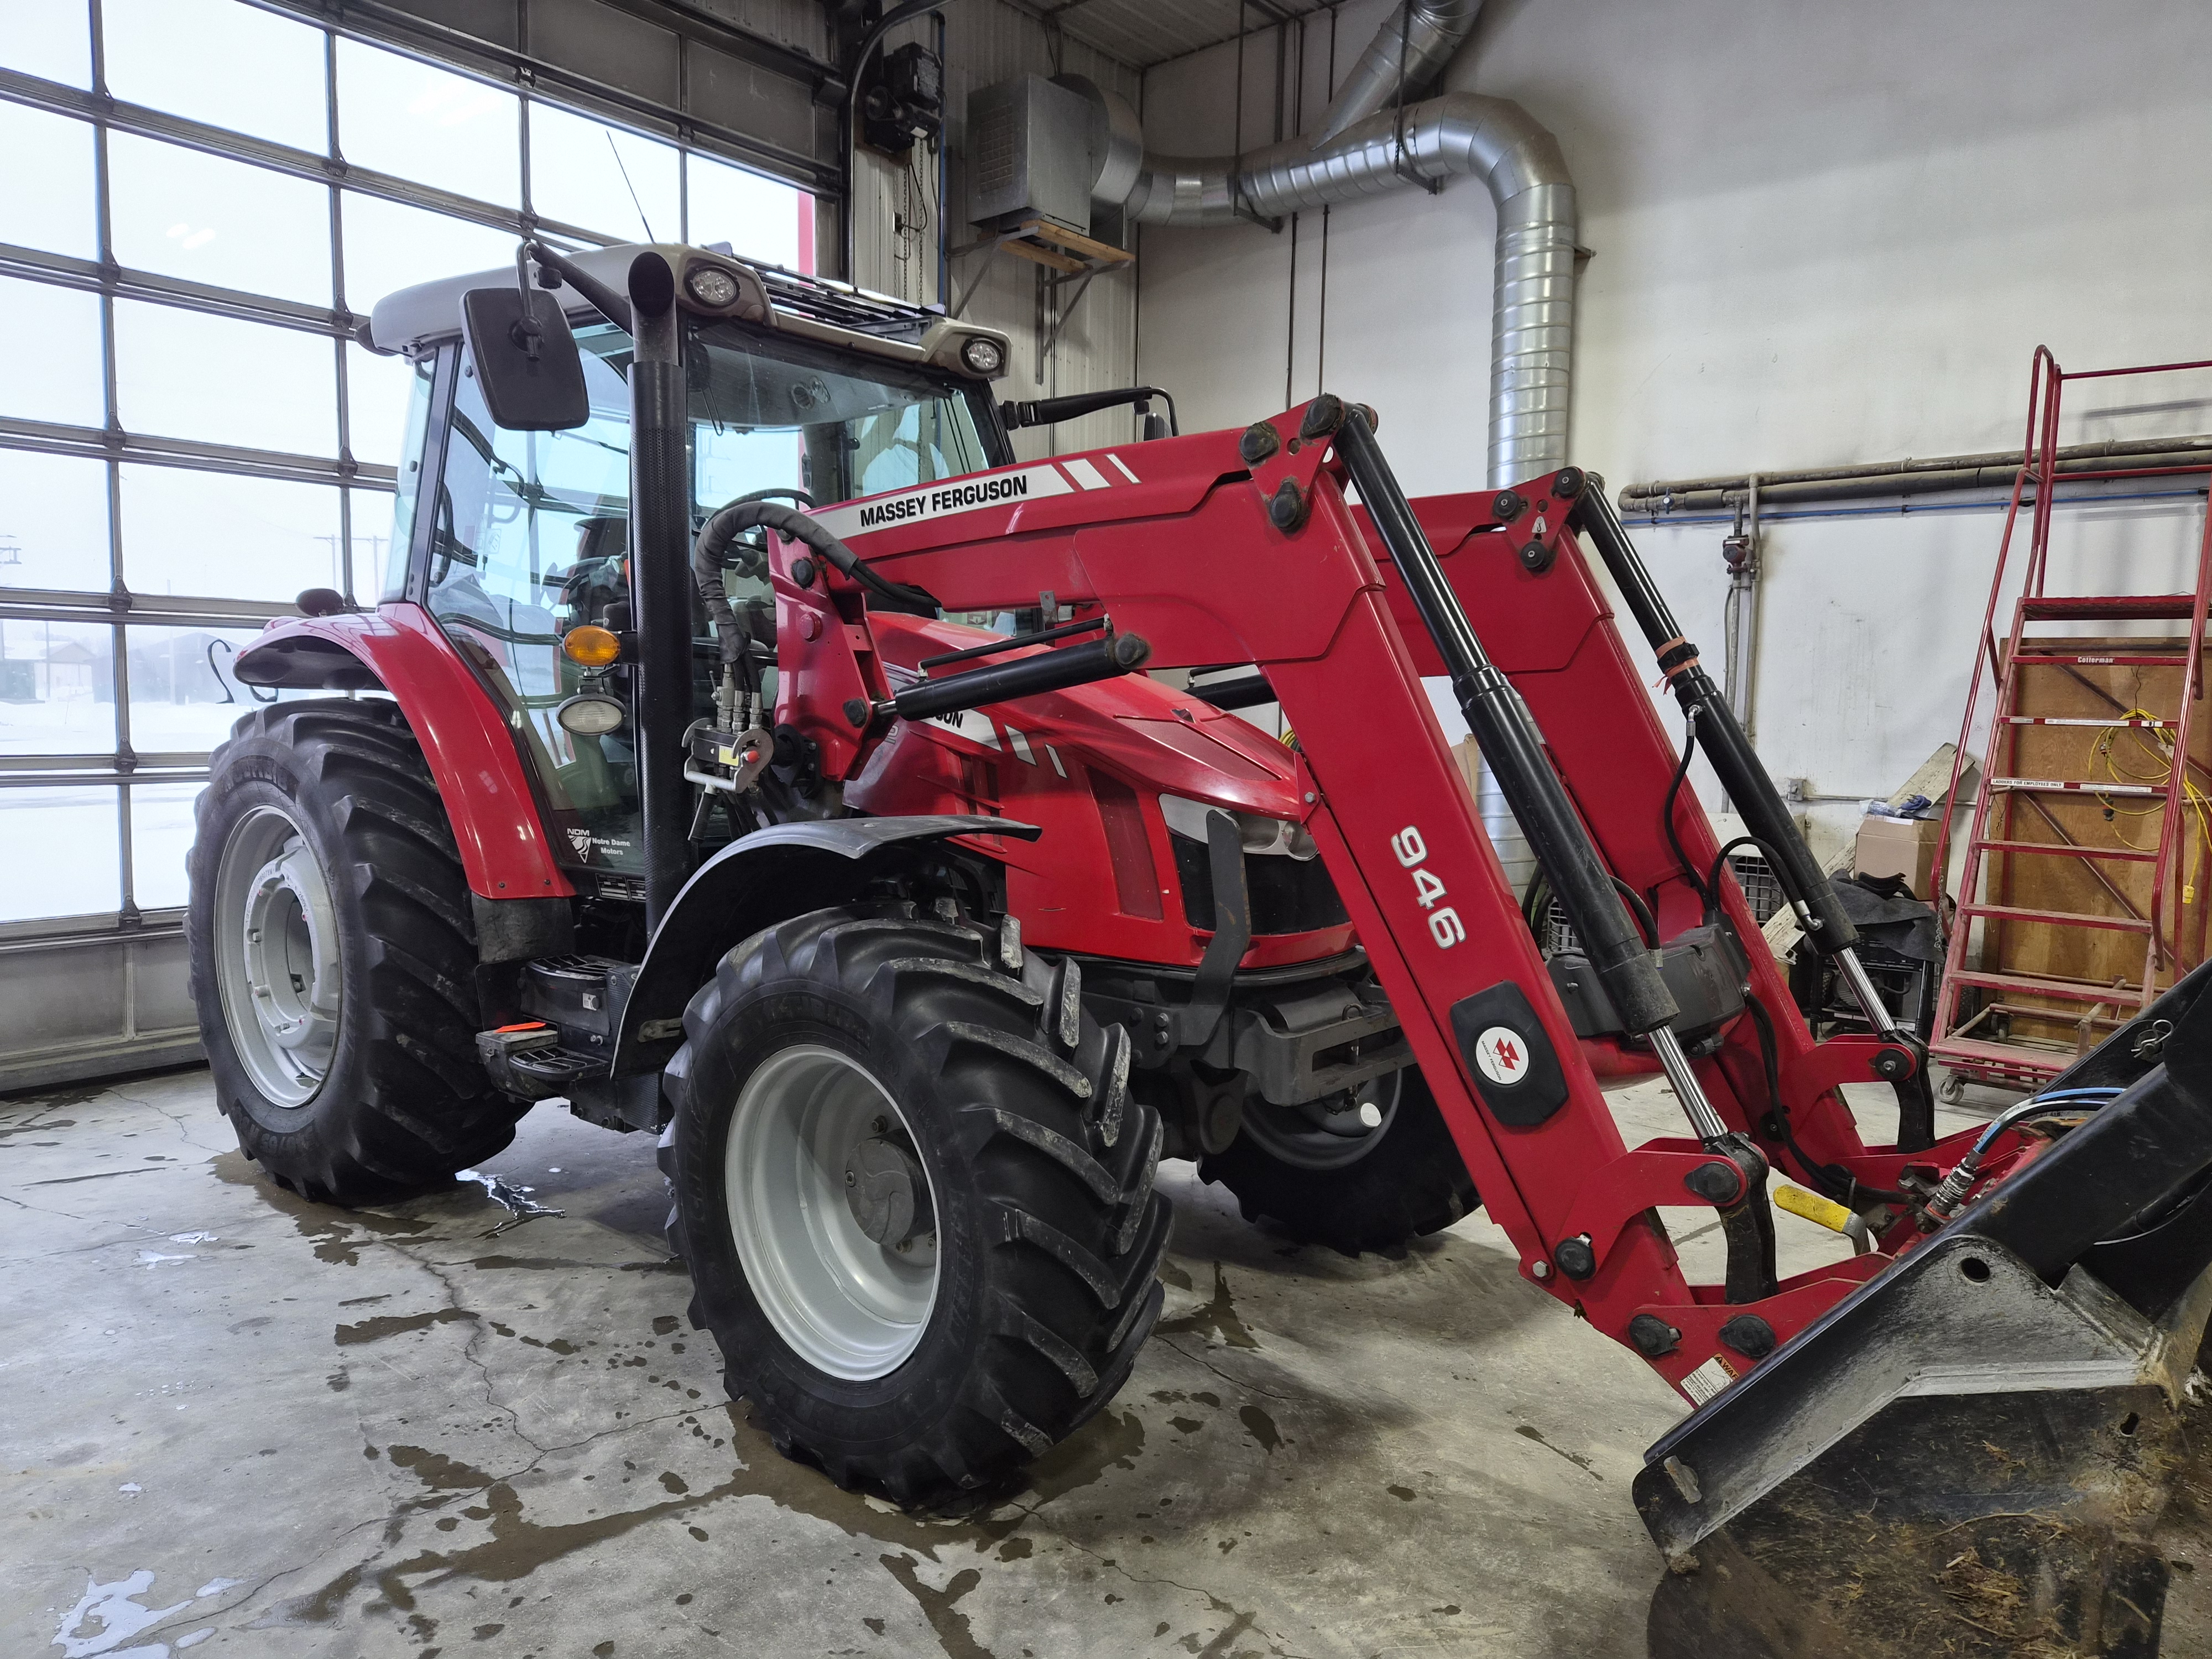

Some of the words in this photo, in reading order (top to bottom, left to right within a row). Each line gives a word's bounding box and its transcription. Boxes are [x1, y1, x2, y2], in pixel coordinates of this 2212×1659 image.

[860, 495, 926, 526] MASSEY
[932, 475, 1027, 512] FERGUSON
[567, 828, 589, 836] NDM
[600, 847, 623, 855] Motors
[1391, 825, 1466, 950] 946
[1481, 1040, 1491, 1058] MASSEY
[1490, 1058, 1503, 1081] FERGUSON
